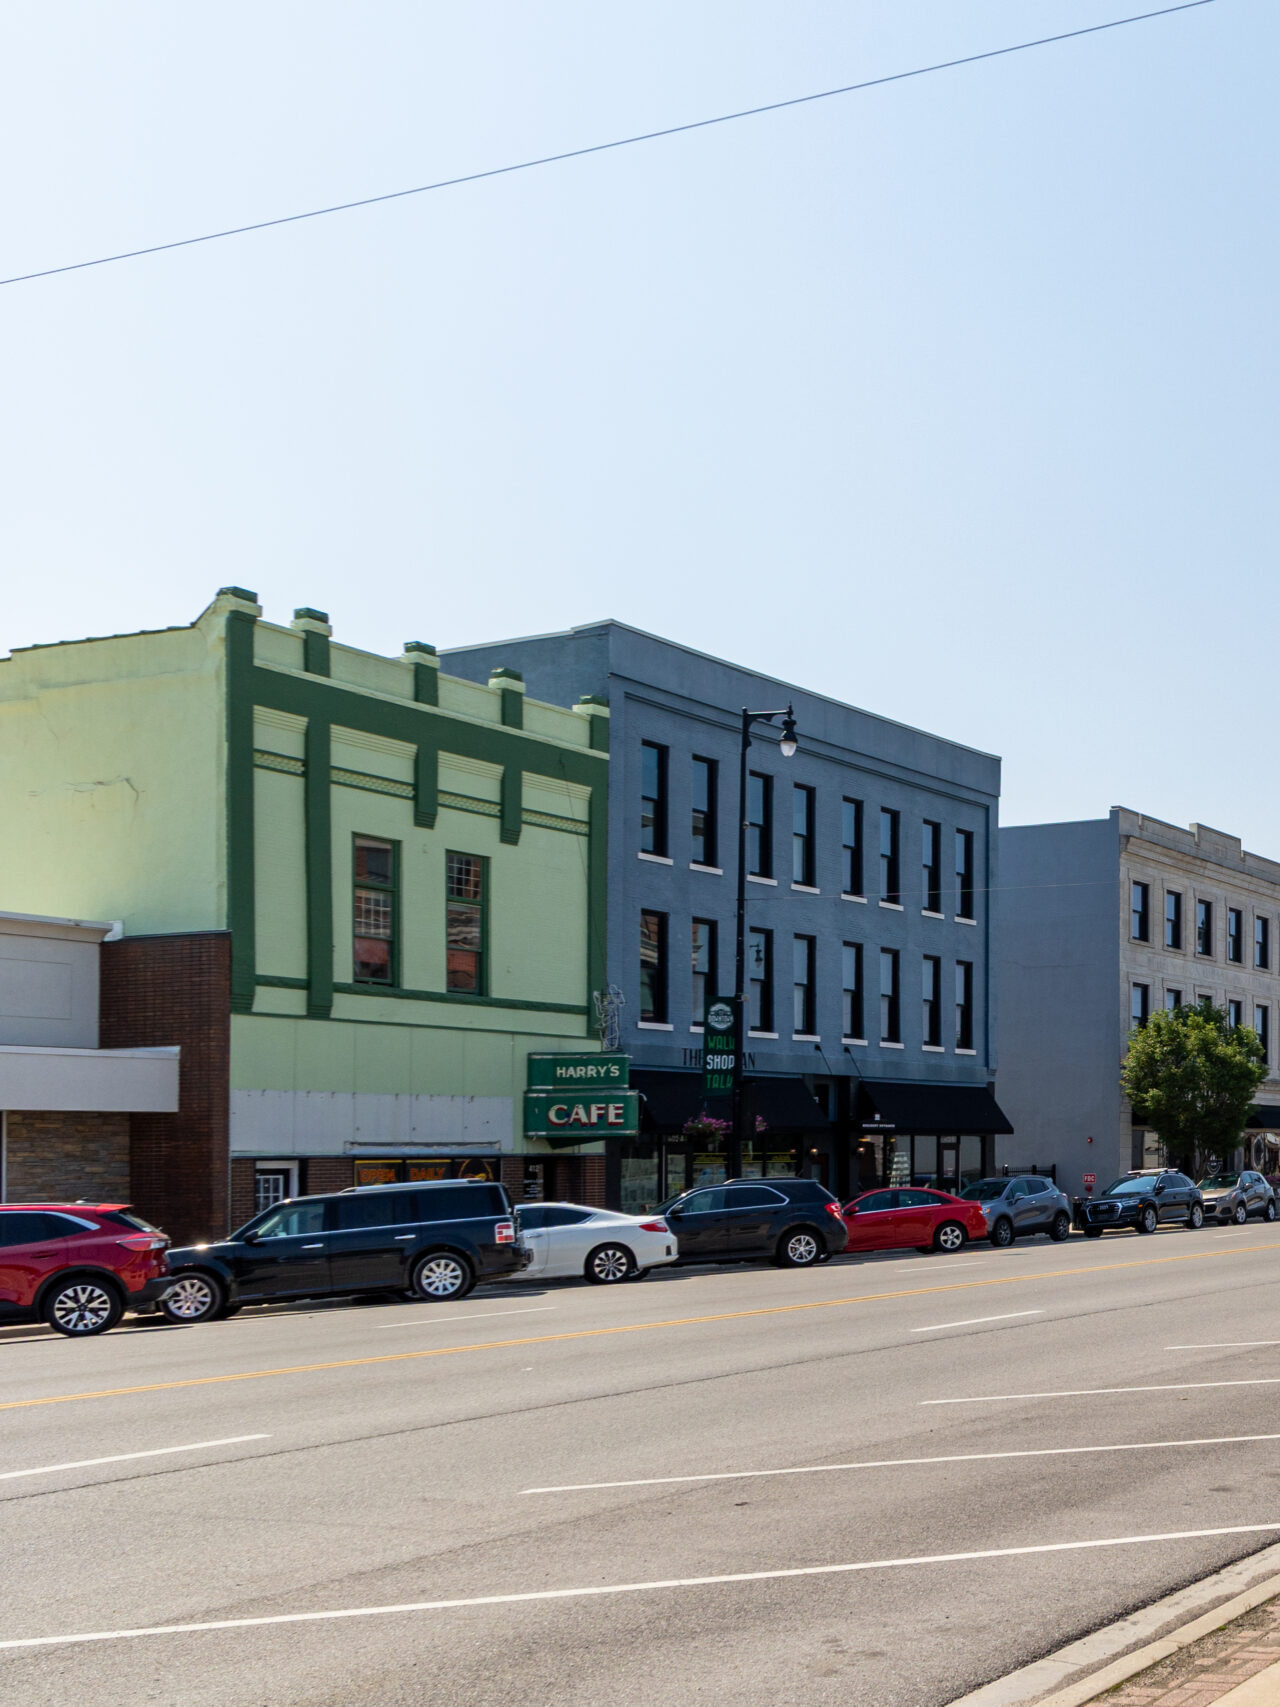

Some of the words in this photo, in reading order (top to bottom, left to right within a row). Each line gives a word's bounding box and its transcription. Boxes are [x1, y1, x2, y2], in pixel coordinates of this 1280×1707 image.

[707, 1035, 735, 1050] WALK
[706, 1054, 735, 1070] SHOP
[556, 1063, 620, 1078] HARRY'S
[706, 1074, 733, 1089] TALK
[547, 1103, 625, 1127] CAFE
[359, 1168, 396, 1182] OPEN
[409, 1167, 446, 1181] DAILY
